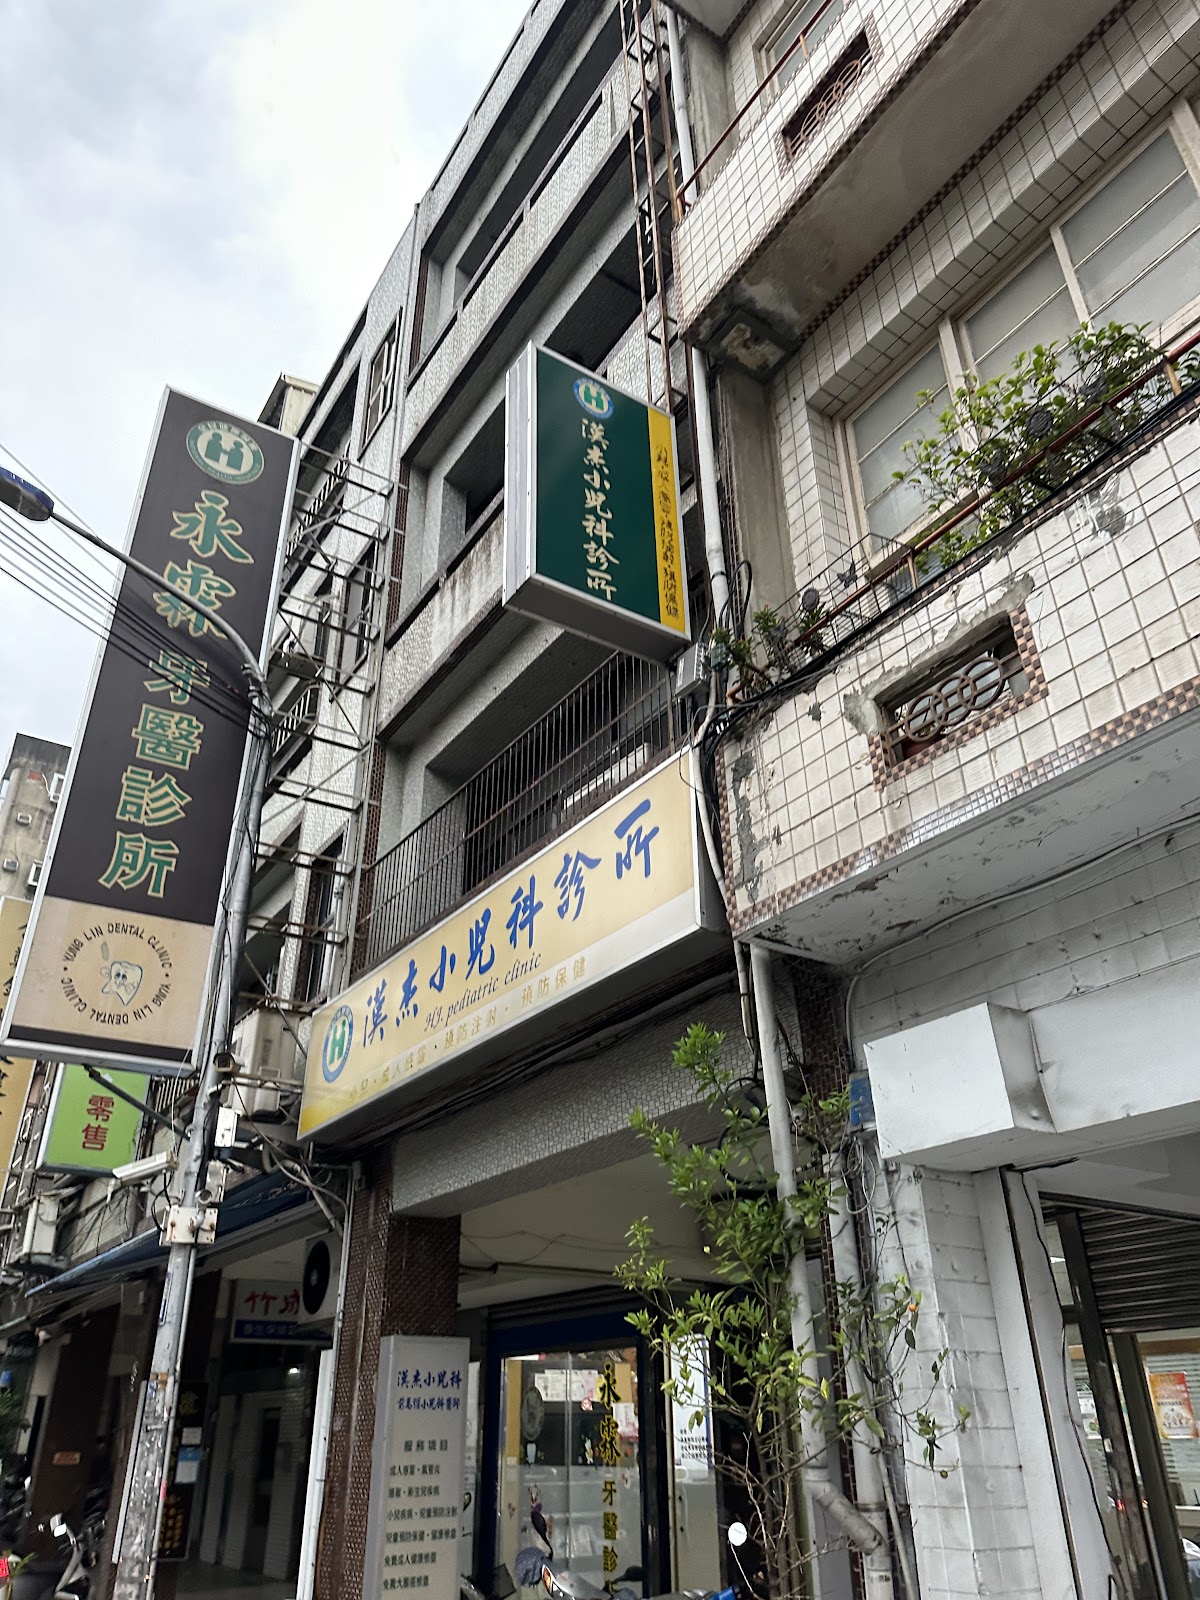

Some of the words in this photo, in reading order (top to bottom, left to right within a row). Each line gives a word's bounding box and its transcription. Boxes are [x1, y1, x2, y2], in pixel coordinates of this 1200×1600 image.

[62, 938, 84, 962] YUNG
[83, 925, 104, 941] LIN
[107, 922, 145, 940] DENTAL
[147, 935, 172, 969] CLINIC
[61, 977, 87, 1013] CLINIC
[152, 982, 171, 1008] YUNG
[446, 976, 499, 1027] pediatric
[504, 952, 542, 986] clinic
[90, 1008, 129, 1025] DENTAL
[133, 1004, 154, 1021] LIN
[81, 1094, 115, 1153] 零售
